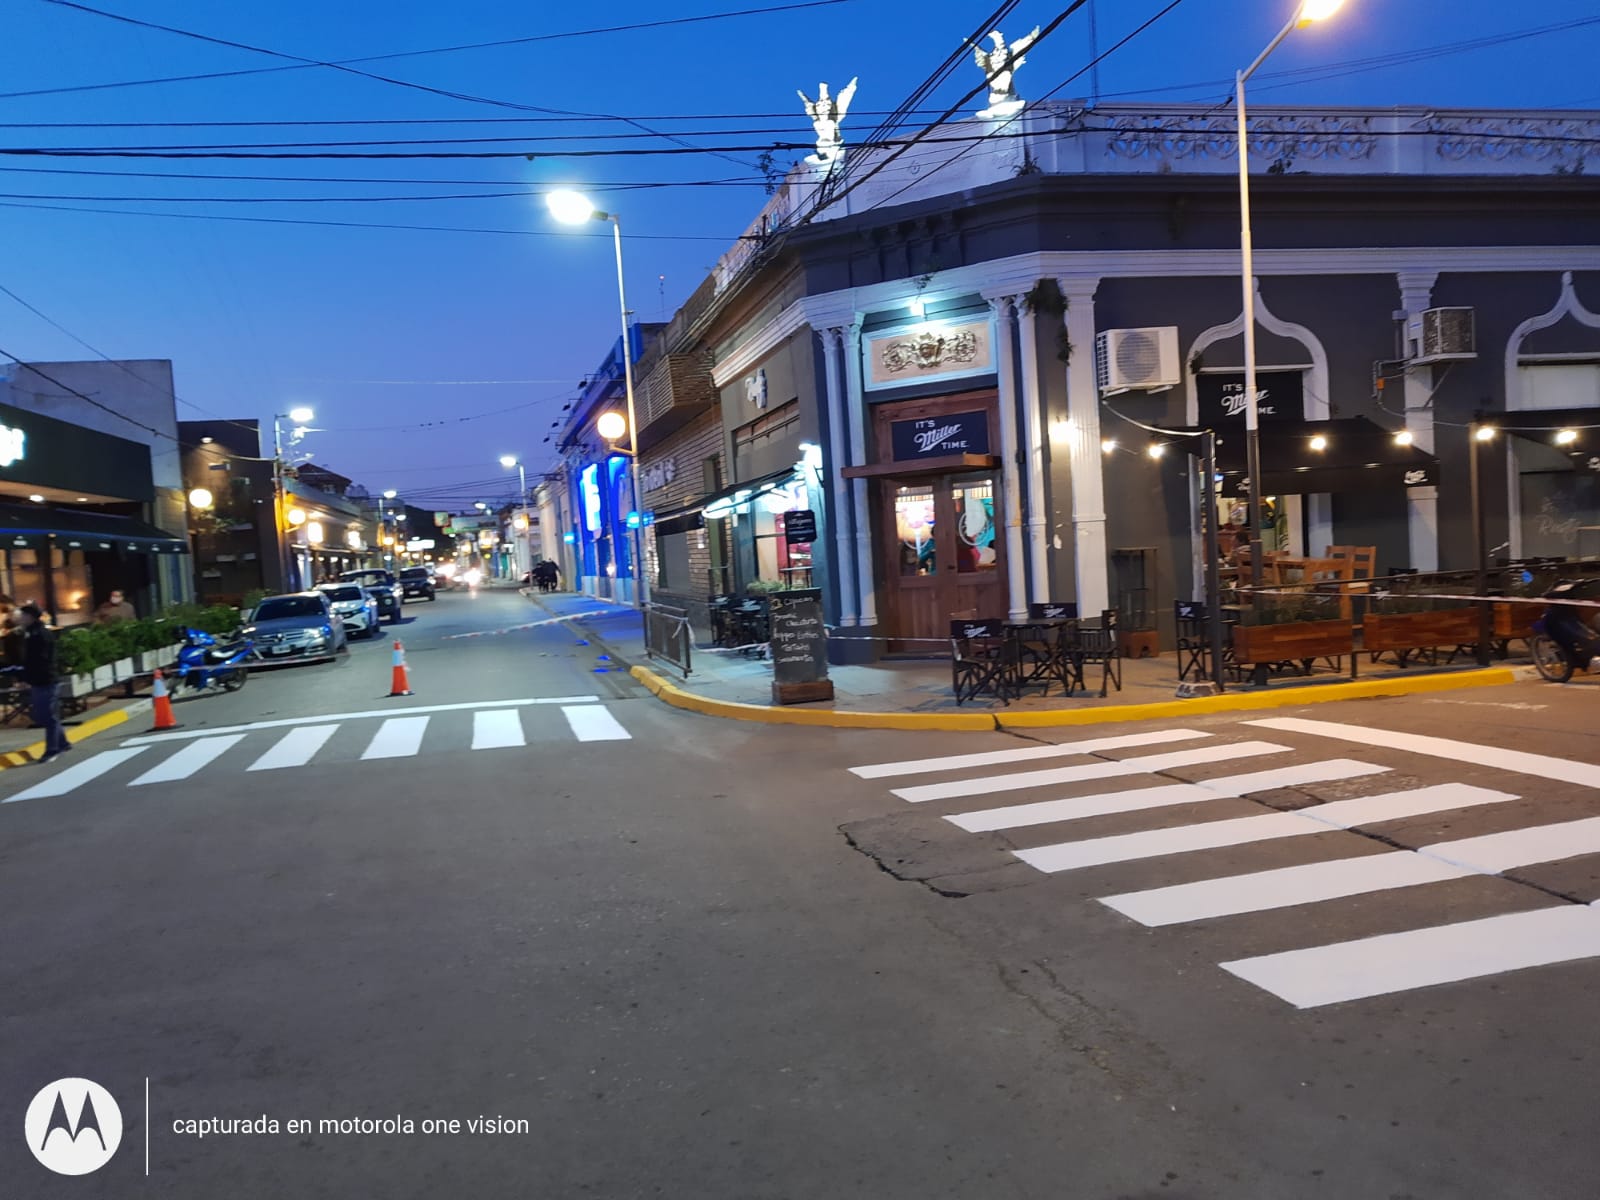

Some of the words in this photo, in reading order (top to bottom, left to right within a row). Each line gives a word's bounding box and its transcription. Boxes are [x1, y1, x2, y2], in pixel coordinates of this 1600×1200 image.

[1222, 383, 1244, 392] IT'S
[915, 419, 936, 430] IT'S
[913, 423, 964, 453] Miller
[941, 440, 969, 450] TIME
